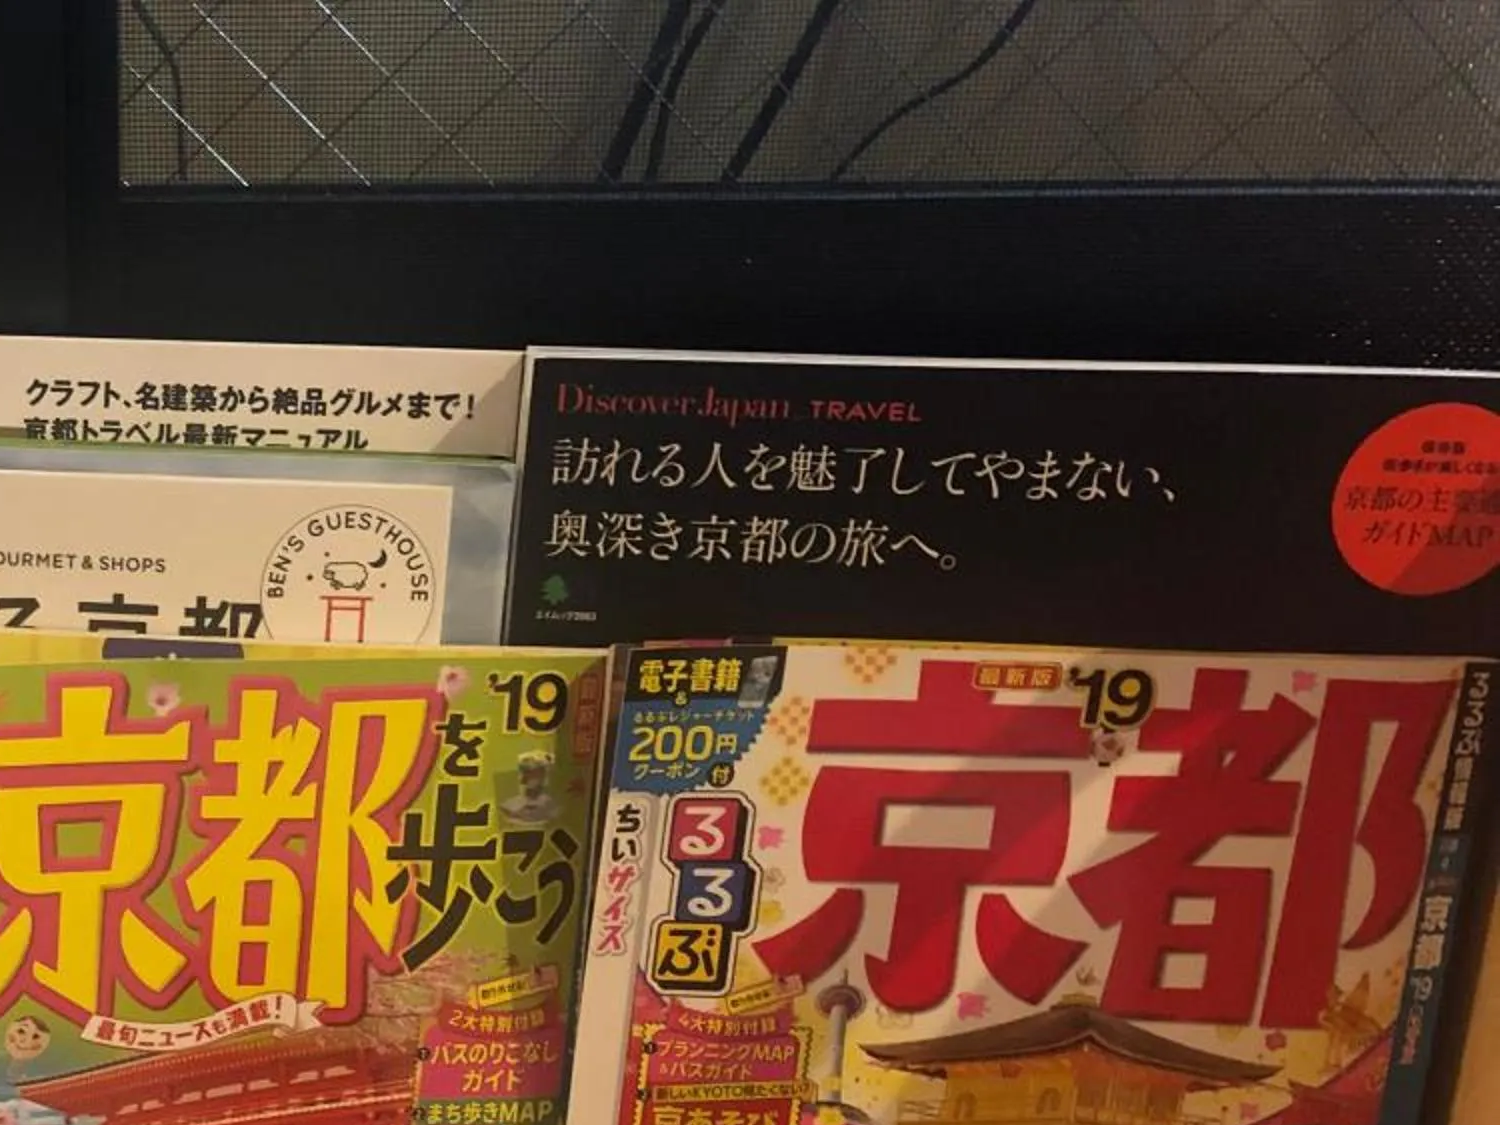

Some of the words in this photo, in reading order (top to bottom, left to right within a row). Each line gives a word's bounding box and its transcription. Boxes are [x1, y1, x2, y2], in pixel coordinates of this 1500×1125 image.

[810, 400, 921, 424] TRAVEL
[553, 437, 1177, 503] 訪れる人を魅了してやまない、
[267, 535, 304, 600] BEN'S
[307, 511, 430, 602] GUESTHOUSE
[545, 508, 956, 570] 奥深き京都の旅へ。
[81, 554, 93, 571] &
[99, 555, 167, 575] SHOPS
[639, 657, 743, 694] 電子書籍
[978, 666, 1056, 690] 最新版
[1069, 669, 1153, 728] '19
[488, 671, 569, 732] '19
[628, 724, 738, 762] 200円
[634, 762, 702, 781] クーポン
[751, 660, 1462, 1029] 京都
[599, 803, 641, 954] ちいサイズ
[658, 806, 736, 977] るるぶ
[462, 1070, 525, 1093] ガイド
[426, 1100, 553, 1125] まち歩きMAP
